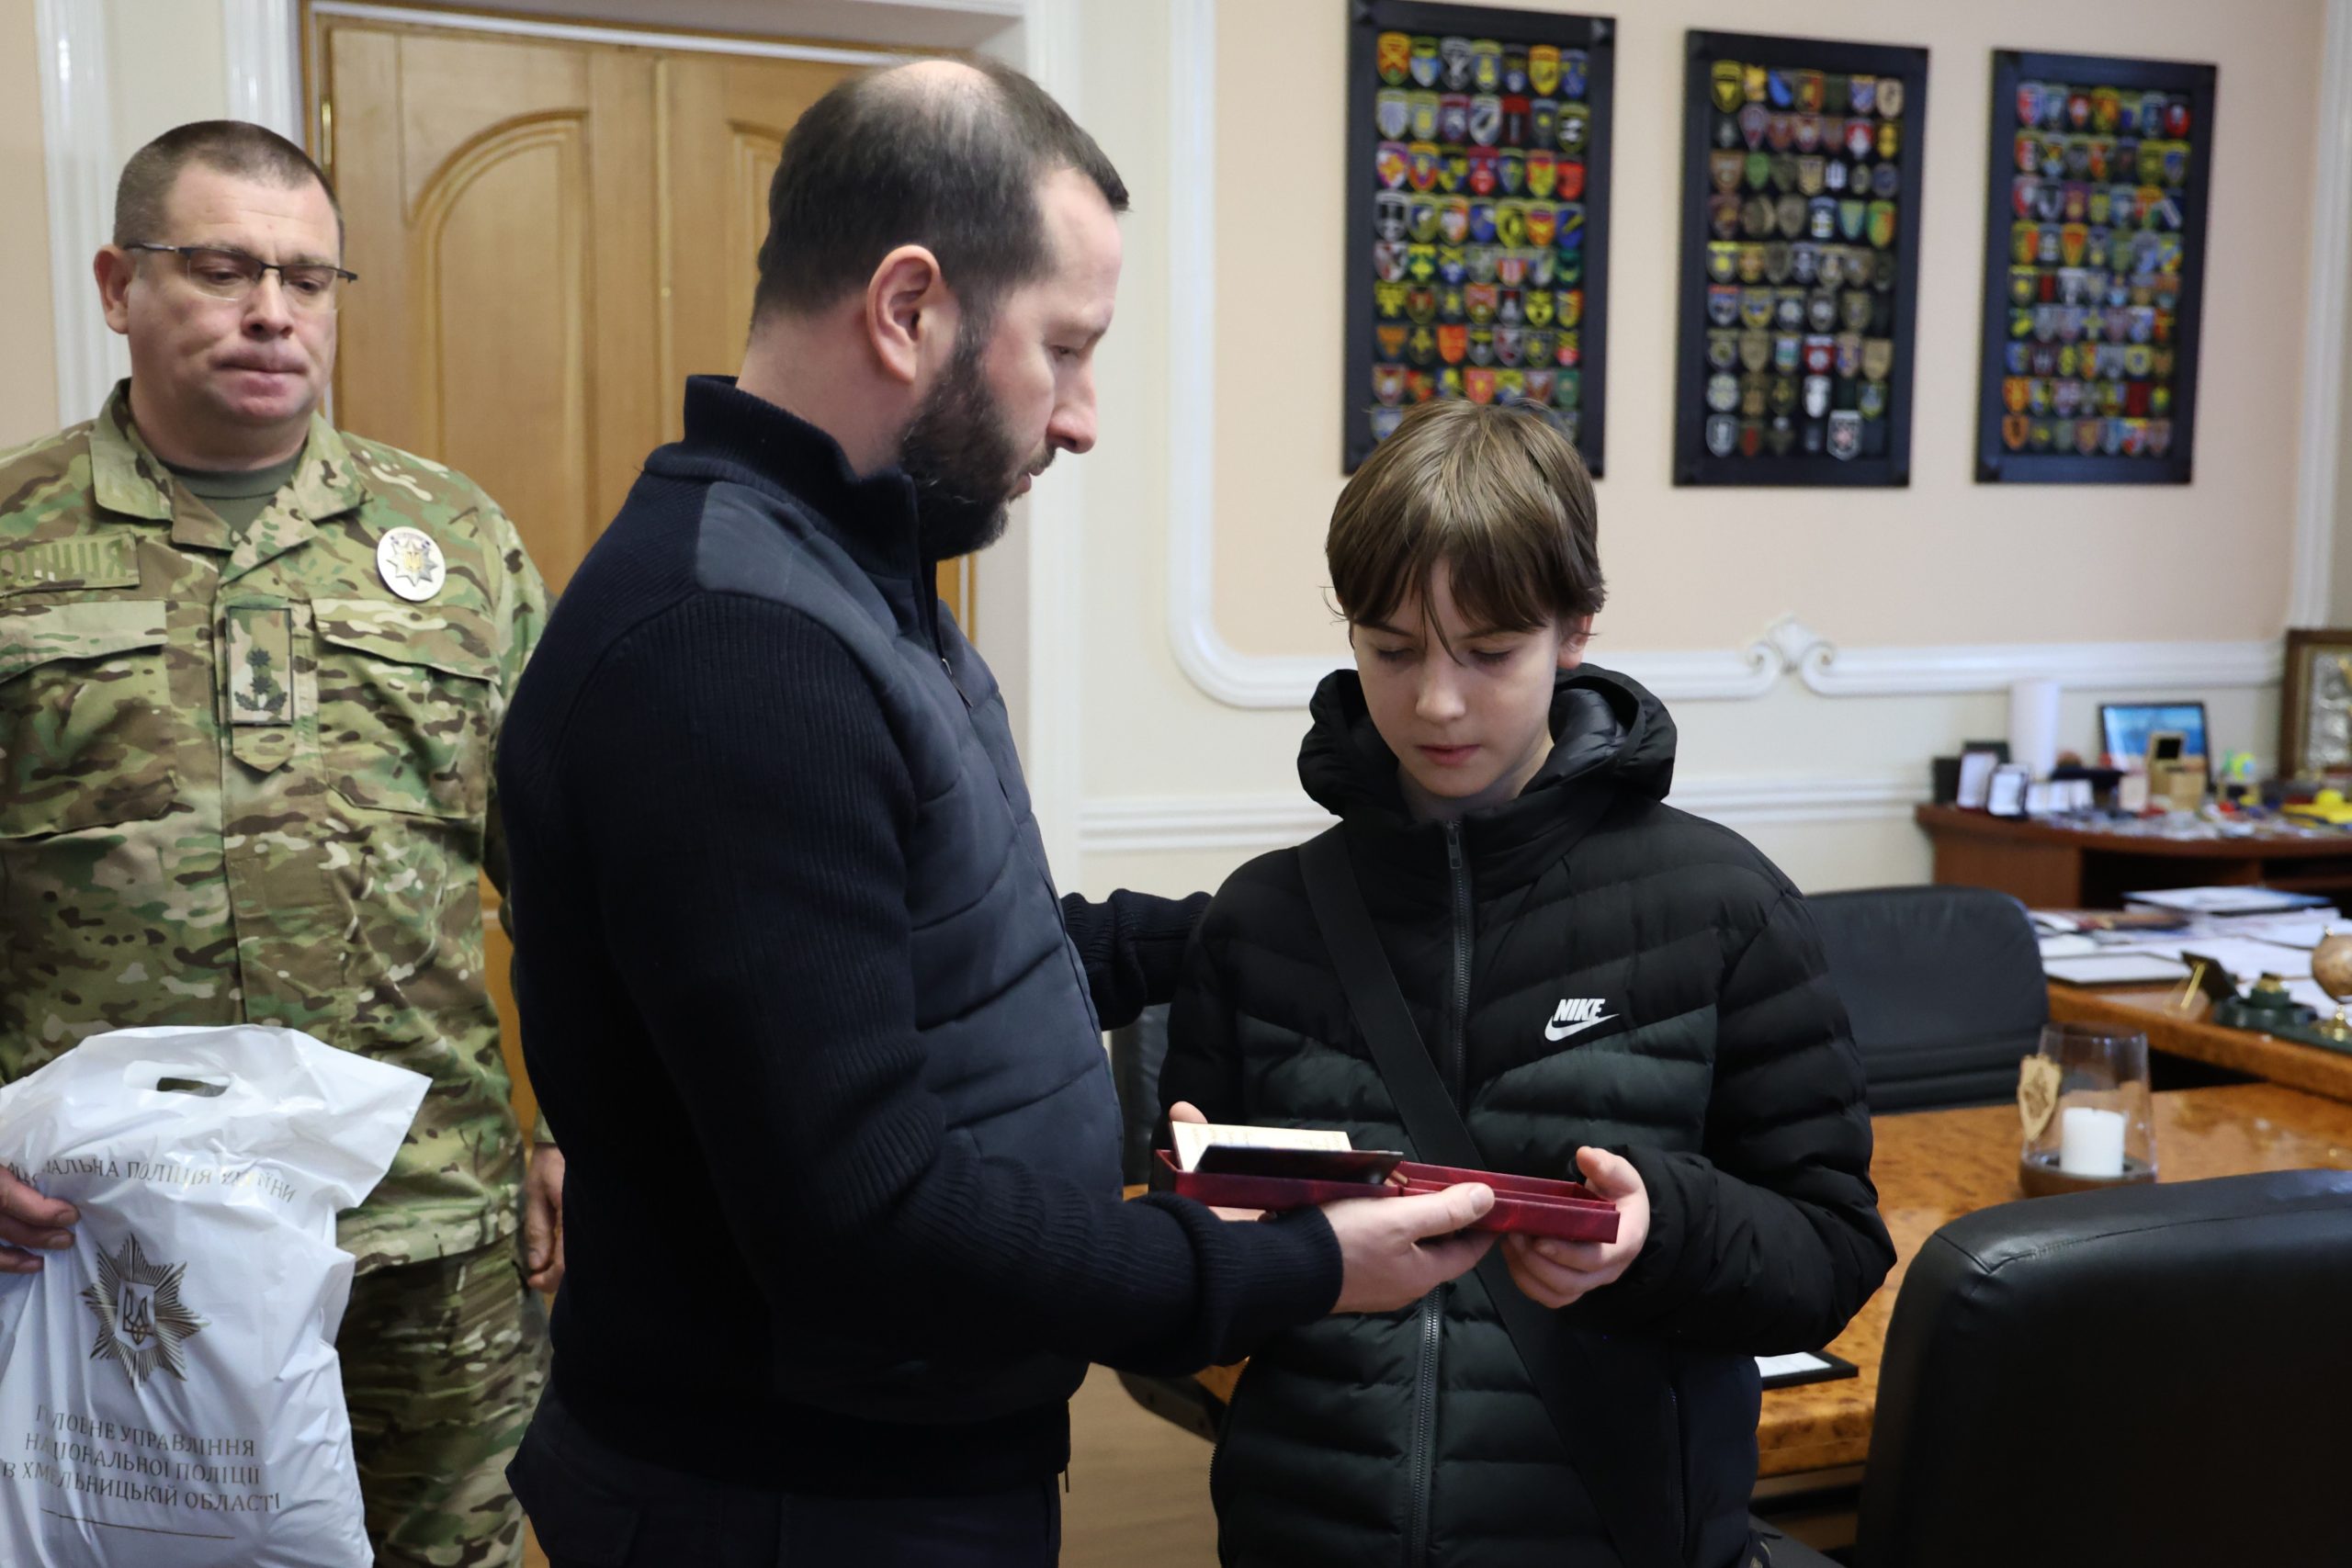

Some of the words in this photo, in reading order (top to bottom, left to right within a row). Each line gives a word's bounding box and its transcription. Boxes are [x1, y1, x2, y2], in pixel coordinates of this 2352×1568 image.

[0, 538, 127, 582] ОЛІЦІЯ
[1553, 998, 1606, 1021] NIKE
[120, 1425, 254, 1457] УПРАВЛІННЯ
[3, 1461, 16, 1478] В
[185, 1491, 280, 1513] ОБЛАСТІ
[176, 1462, 261, 1486] ПОЛІЦІЇ
